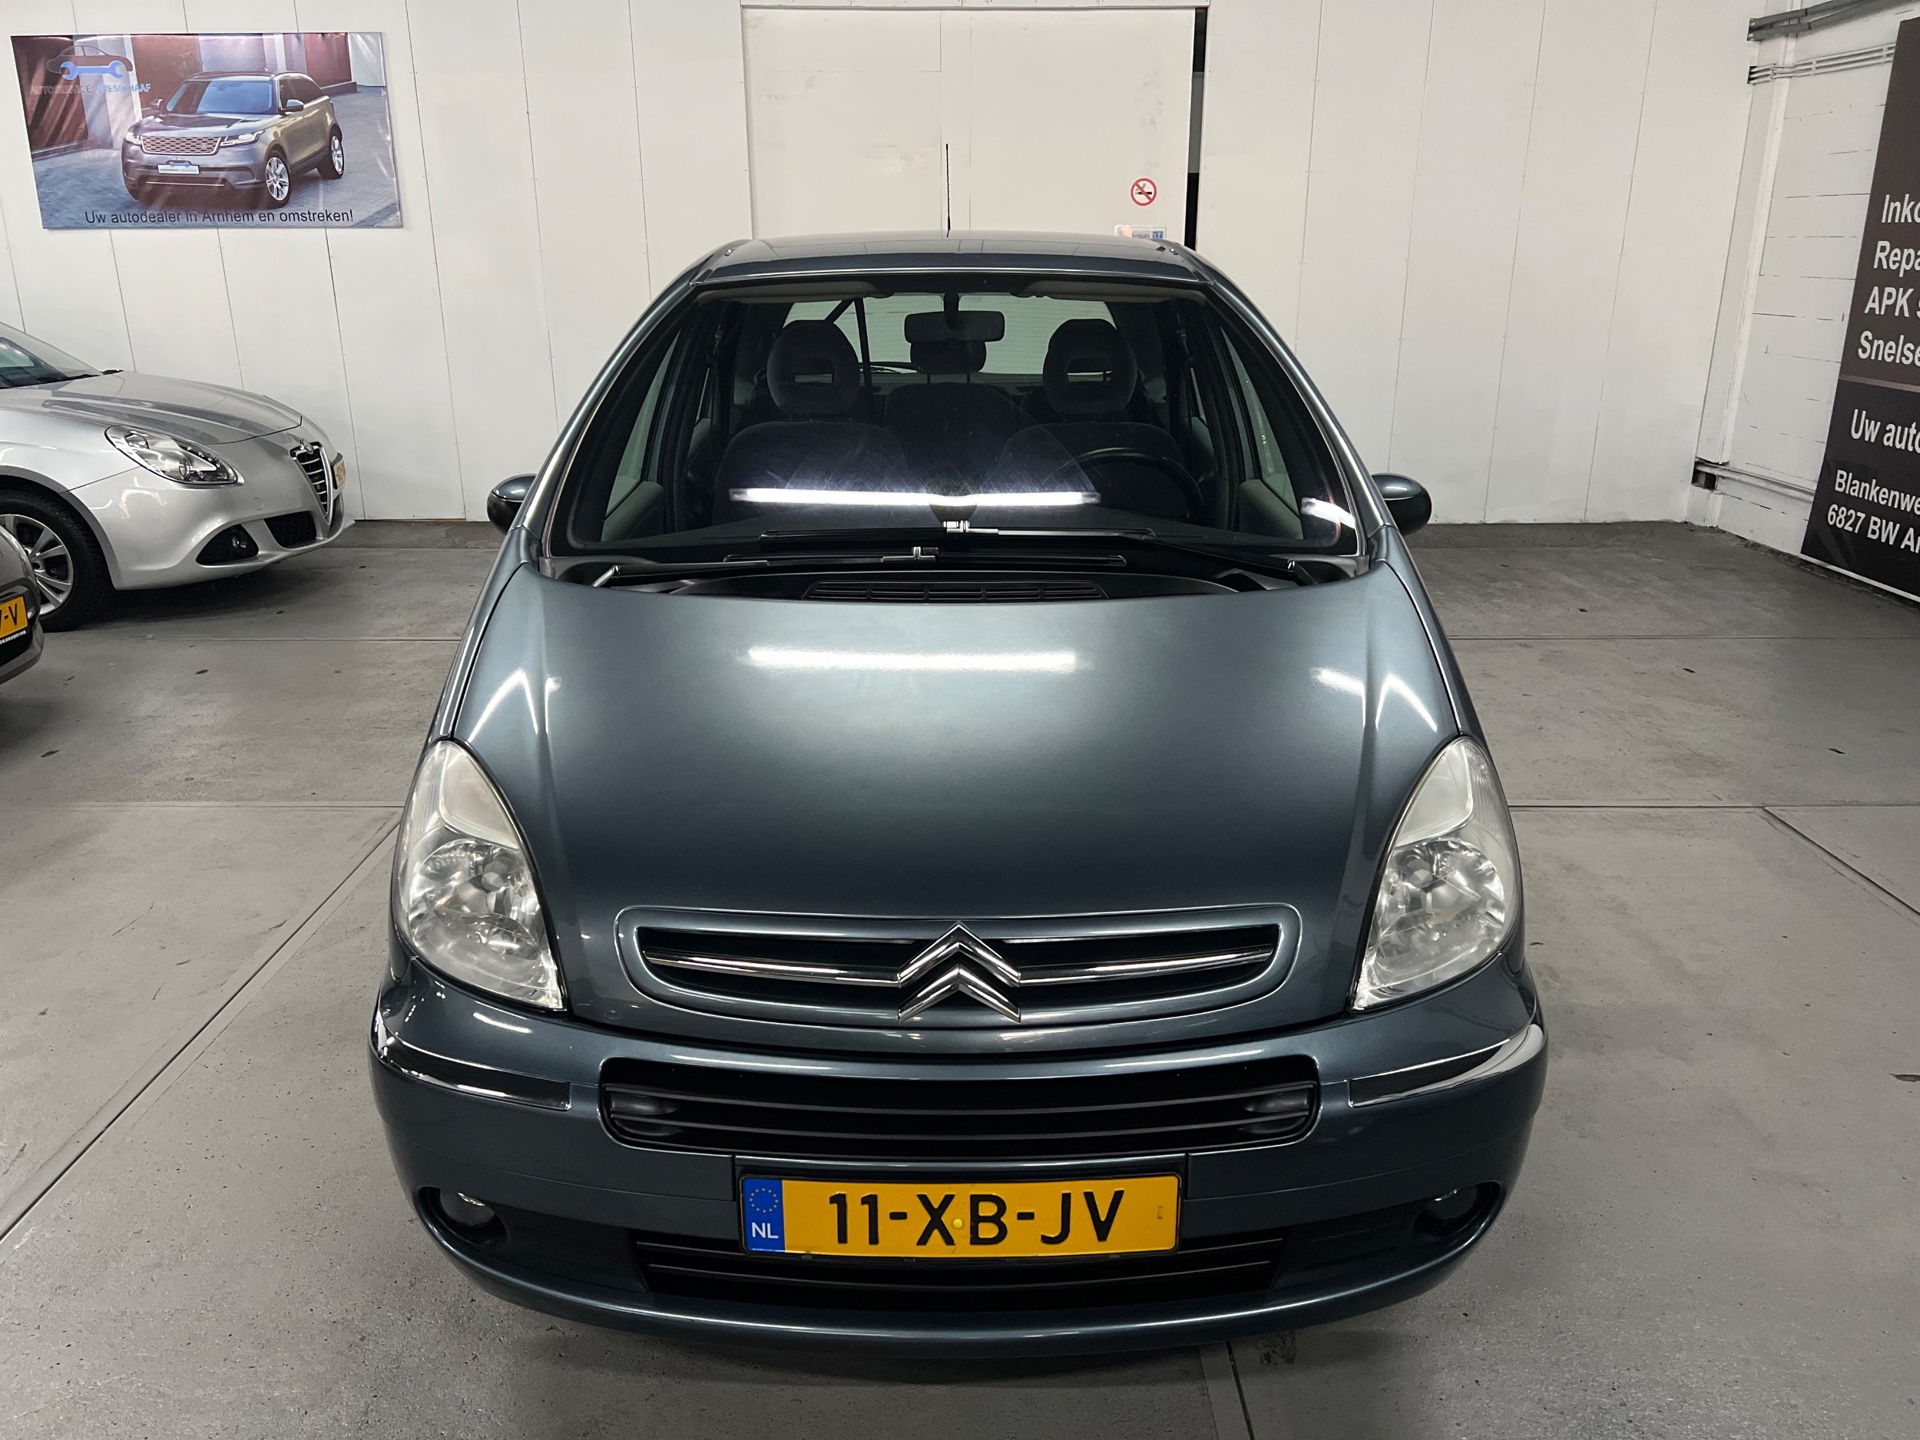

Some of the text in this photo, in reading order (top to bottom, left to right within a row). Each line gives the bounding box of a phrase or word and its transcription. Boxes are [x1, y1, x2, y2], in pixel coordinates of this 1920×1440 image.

[85, 209, 354, 224] Uw autodealer in Arnhem en omstreken!
[1864, 286, 1914, 317] APK
[1851, 408, 1881, 443] Uw
[1827, 503, 1866, 534] 6827
[1867, 516, 1900, 546] BW
[0, 603, 17, 633] -V
[751, 1189, 1125, 1246] NL 11-XB-JV
